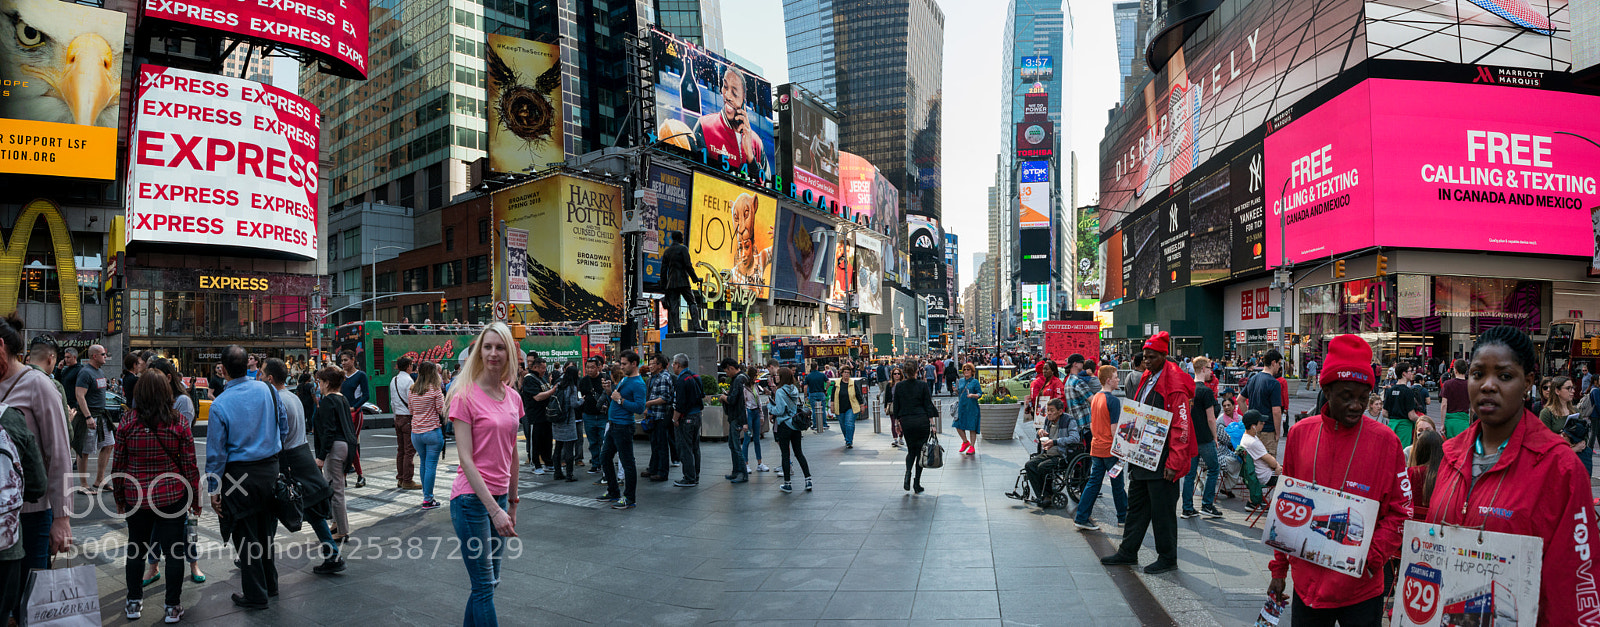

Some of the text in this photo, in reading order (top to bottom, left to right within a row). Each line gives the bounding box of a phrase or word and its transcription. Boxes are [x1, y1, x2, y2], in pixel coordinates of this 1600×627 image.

[146, 0, 239, 26] EXPRESS
[250, 17, 331, 48] EXPRESS
[497, 43, 553, 58] #KeepTheSecrets
[1025, 58, 1048, 67] 3:57
[1498, 68, 1545, 79] MARRIOTT
[1499, 76, 1540, 86] MARQUIS
[0, 79, 29, 88] OPE
[241, 87, 311, 122] EXPRESS
[143, 99, 316, 150] EXPRESS EXPRESS
[9, 134, 63, 148] SUPPORT
[68, 138, 87, 149] LSF
[1466, 129, 1553, 168] FREE
[1017, 149, 1053, 157] TOSHIBA
[136, 129, 318, 194] EXPRESS
[1291, 143, 1333, 189] FREE
[1308, 185, 1316, 203] &
[1316, 168, 1359, 200] TEXTING
[1421, 163, 1597, 195] CALLING & TEXTING
[138, 182, 315, 222] EXPRESS EXPRESS
[508, 191, 540, 204] BROADWAY
[569, 184, 615, 211] HARRY
[703, 194, 720, 211] FEEL
[724, 200, 733, 213] TH
[1438, 187, 1583, 211] IN CANADA AND MEXICO
[508, 201, 528, 211] SPRING
[1286, 193, 1350, 226] CANADA AND MEXICO
[566, 201, 619, 229] POTTER
[658, 215, 685, 232] OME
[236, 219, 308, 247] EXPRESS
[573, 227, 614, 240] CURSED CHILD
[694, 213, 740, 254] JOY
[576, 258, 598, 267] SPRING
[577, 251, 611, 261] BROADWAY
[199, 275, 269, 291] EXPRESS
[551, 349, 579, 357] Square's
[833, 346, 842, 355] NEW
[1346, 480, 1371, 492] TOPVIEW
[1278, 499, 1308, 521] $29
[1478, 505, 1514, 519] TOPVIEW
[1410, 565, 1436, 578] STARTING AT
[1454, 561, 1475, 574] HOP
[61, 586, 79, 600] AM
[1405, 576, 1435, 613] $29
[34, 601, 97, 620] #aerieREAL
